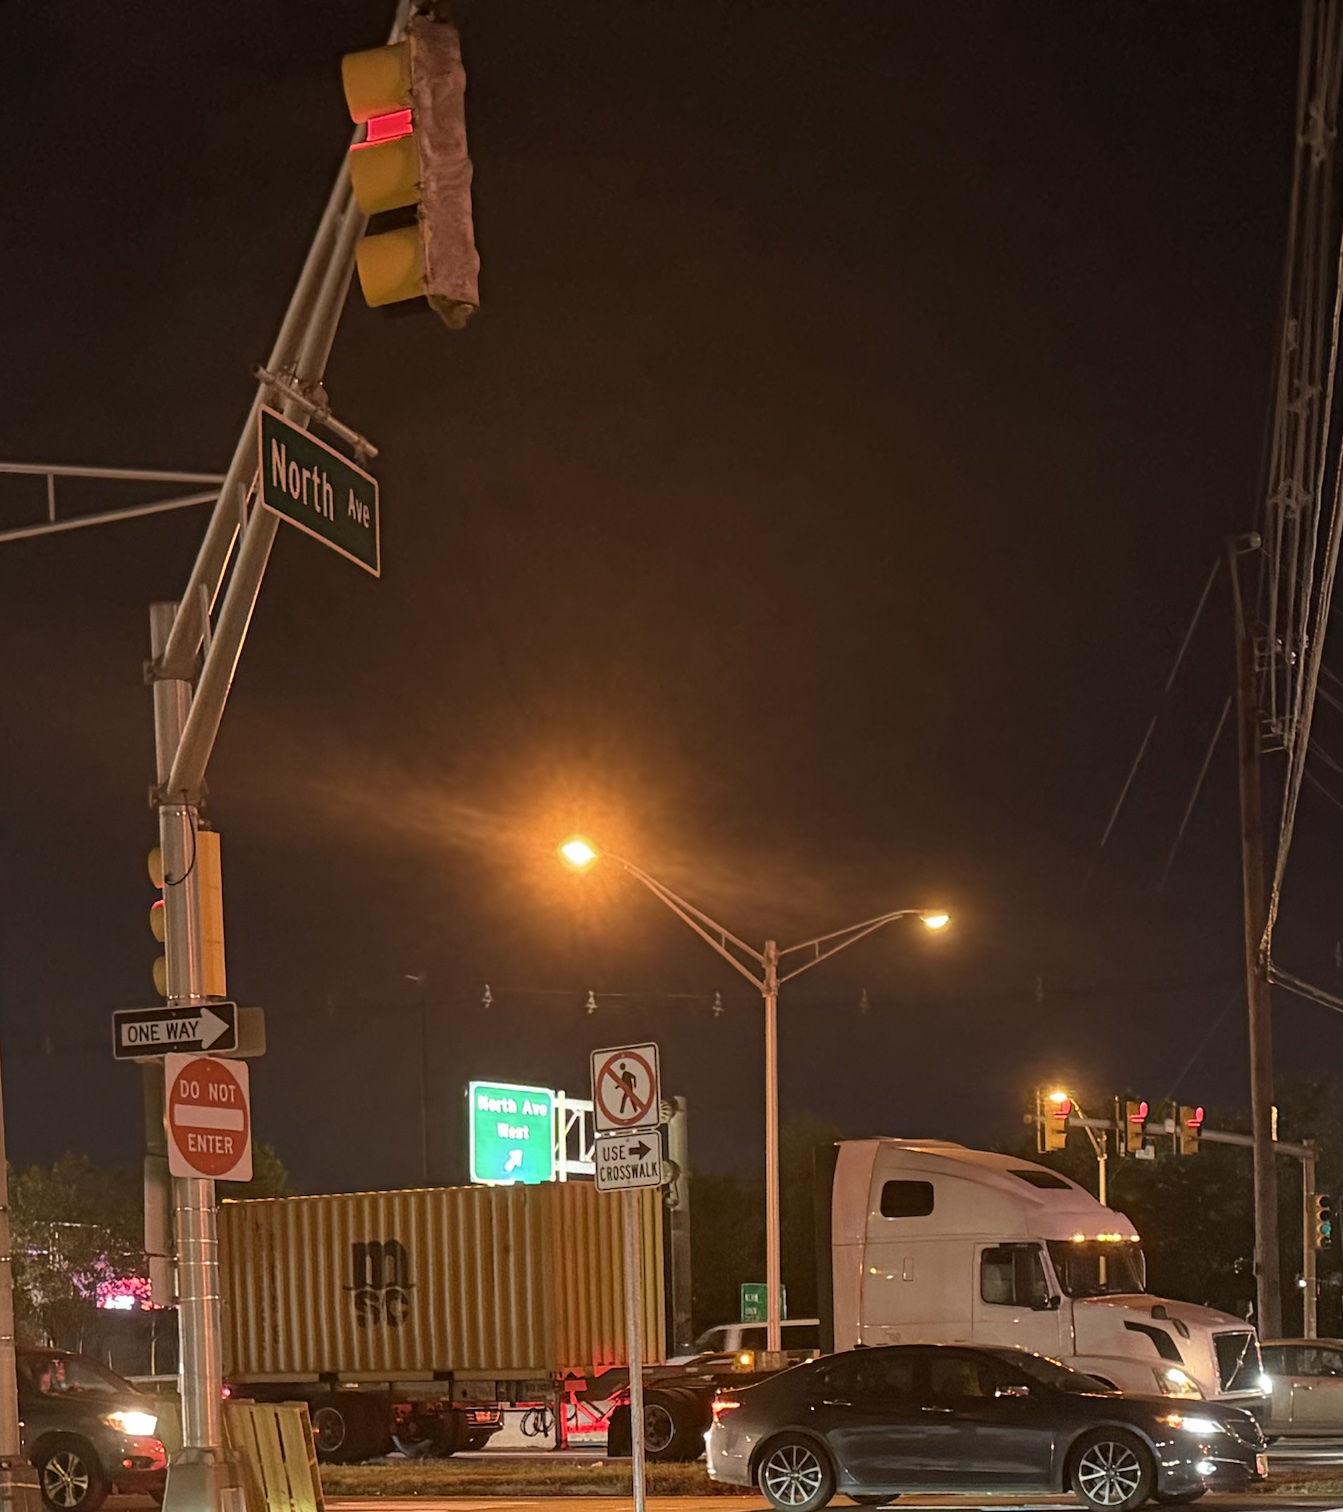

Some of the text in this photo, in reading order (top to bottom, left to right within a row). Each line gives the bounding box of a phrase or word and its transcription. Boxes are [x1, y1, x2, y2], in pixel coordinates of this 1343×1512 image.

[271, 437, 371, 529] North Ave
[127, 1020, 199, 1043] ONE WAY
[179, 1079, 236, 1103] DO NOT
[477, 1096, 548, 1116] North Ave
[497, 1123, 530, 1141] West
[187, 1133, 234, 1154] ENTER
[602, 1144, 627, 1163] USE
[599, 1161, 659, 1183] CROSSWALK
